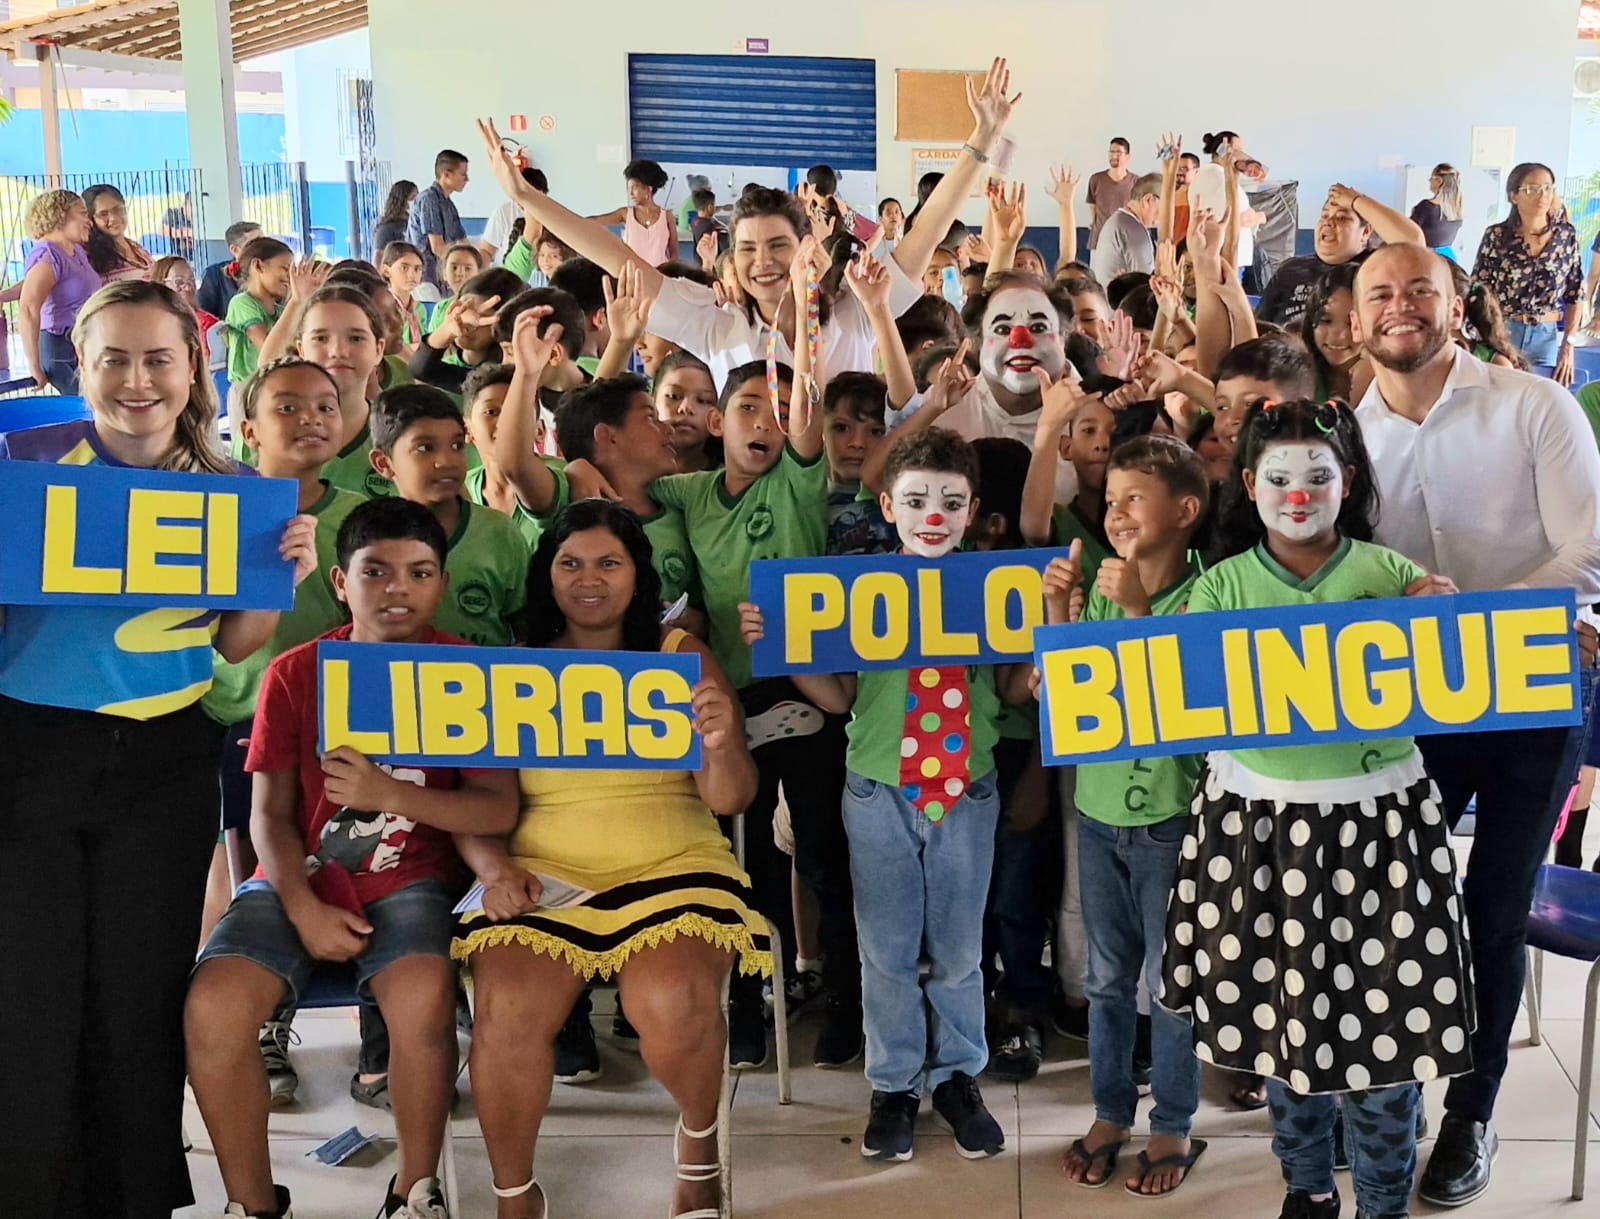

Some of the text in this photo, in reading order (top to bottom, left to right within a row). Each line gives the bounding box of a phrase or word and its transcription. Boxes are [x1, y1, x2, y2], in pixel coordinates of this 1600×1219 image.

[42, 485, 238, 595] LEI
[784, 565, 1045, 663] POLO
[323, 659, 692, 759] LIBRAS
[1043, 606, 1573, 757] BILINGUE
